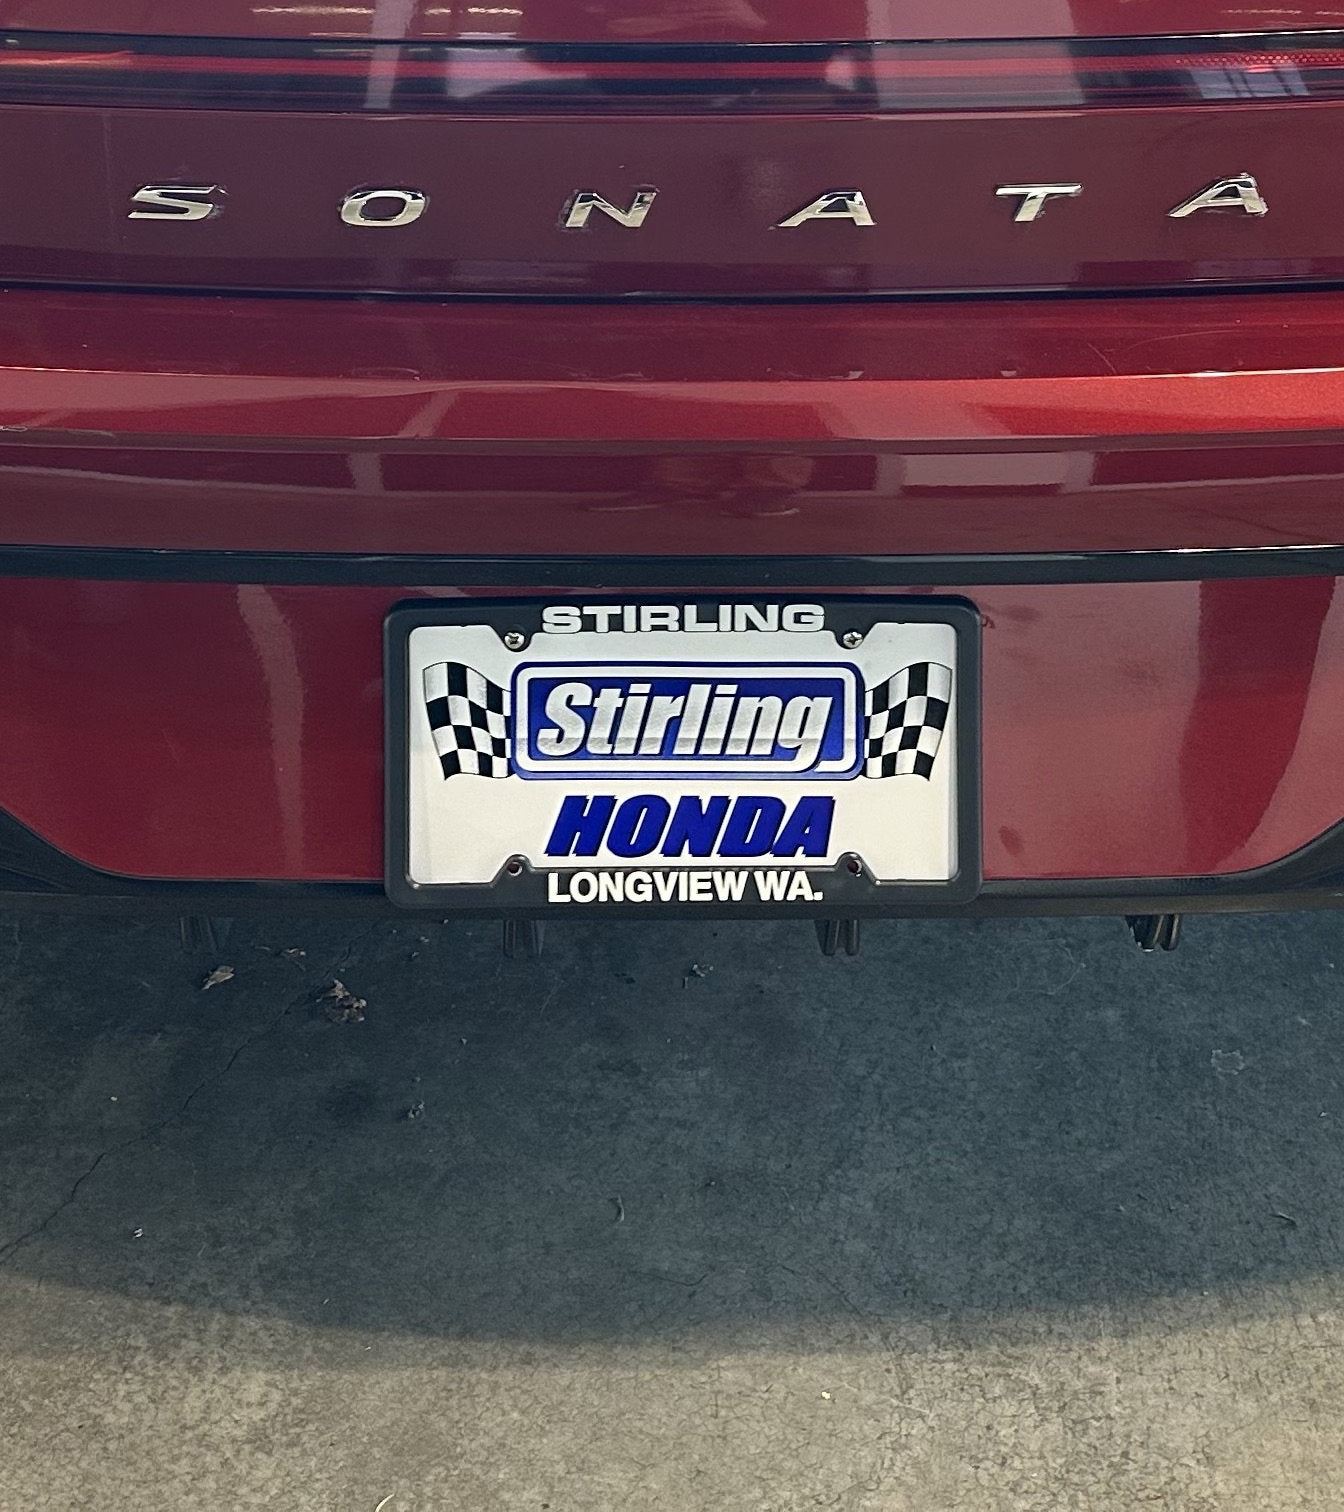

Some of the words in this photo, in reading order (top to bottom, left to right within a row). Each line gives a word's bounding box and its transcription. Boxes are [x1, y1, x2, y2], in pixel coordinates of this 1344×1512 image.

[128, 173, 1268, 228] SONATA
[542, 604, 825, 634] STIRLING
[537, 682, 834, 768] Stirling
[544, 794, 836, 858] HONDA
[547, 870, 748, 903] LONGVIEW
[754, 870, 824, 901] WA.
